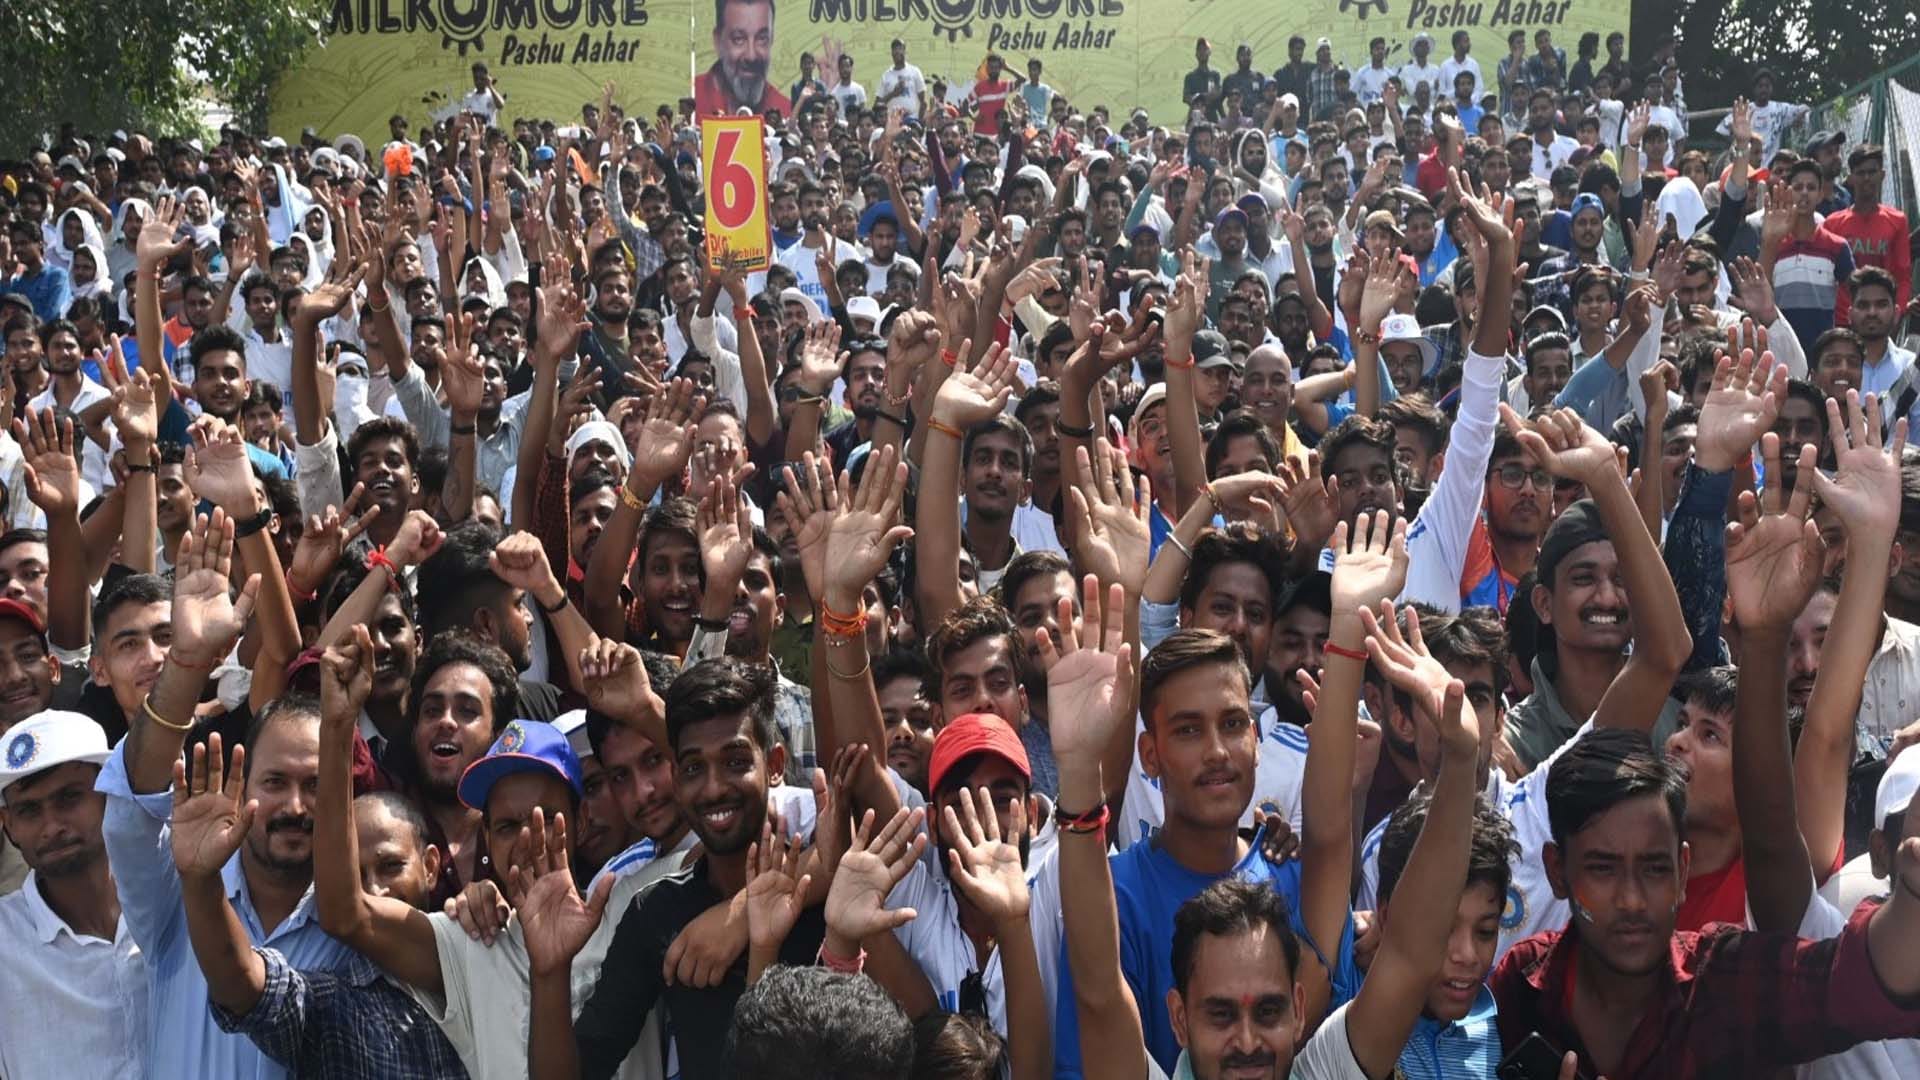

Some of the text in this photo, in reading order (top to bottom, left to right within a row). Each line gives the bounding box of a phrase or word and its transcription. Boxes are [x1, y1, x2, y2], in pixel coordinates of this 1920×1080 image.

[1406, 0, 1572, 29] Pashu Aahar
[500, 30, 641, 66] Pashu Aahar
[987, 20, 1116, 51] Pashu Aahar
[710, 128, 757, 231] 6
